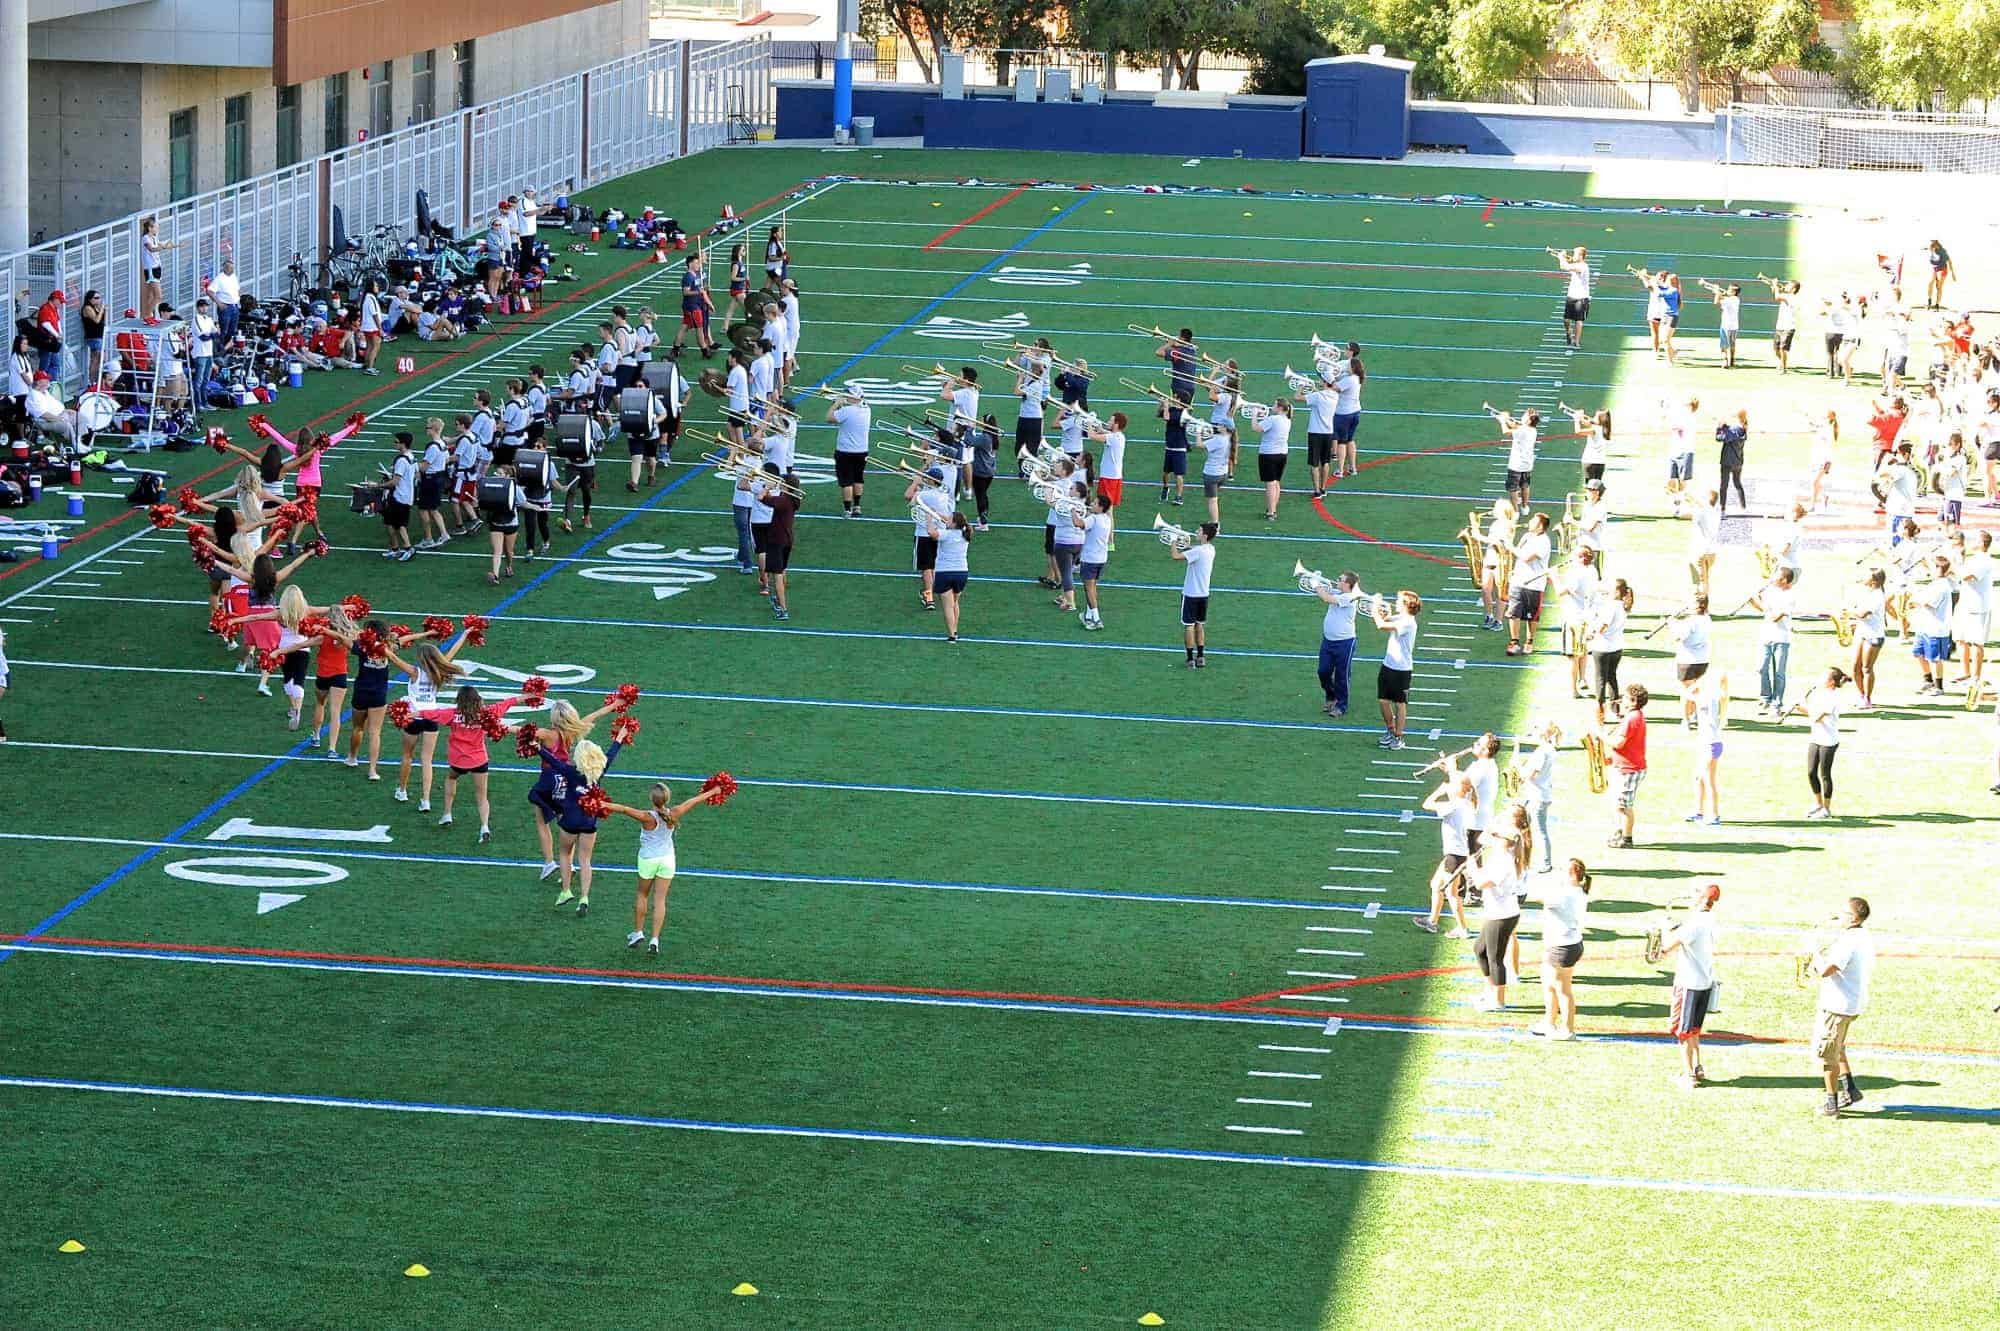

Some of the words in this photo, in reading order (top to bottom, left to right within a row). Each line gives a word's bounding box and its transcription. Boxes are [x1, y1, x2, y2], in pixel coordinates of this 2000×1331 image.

[913, 316, 1030, 339] 20
[398, 357, 413, 372] 40
[578, 543, 739, 583] 30
[164, 818, 393, 886] 10
